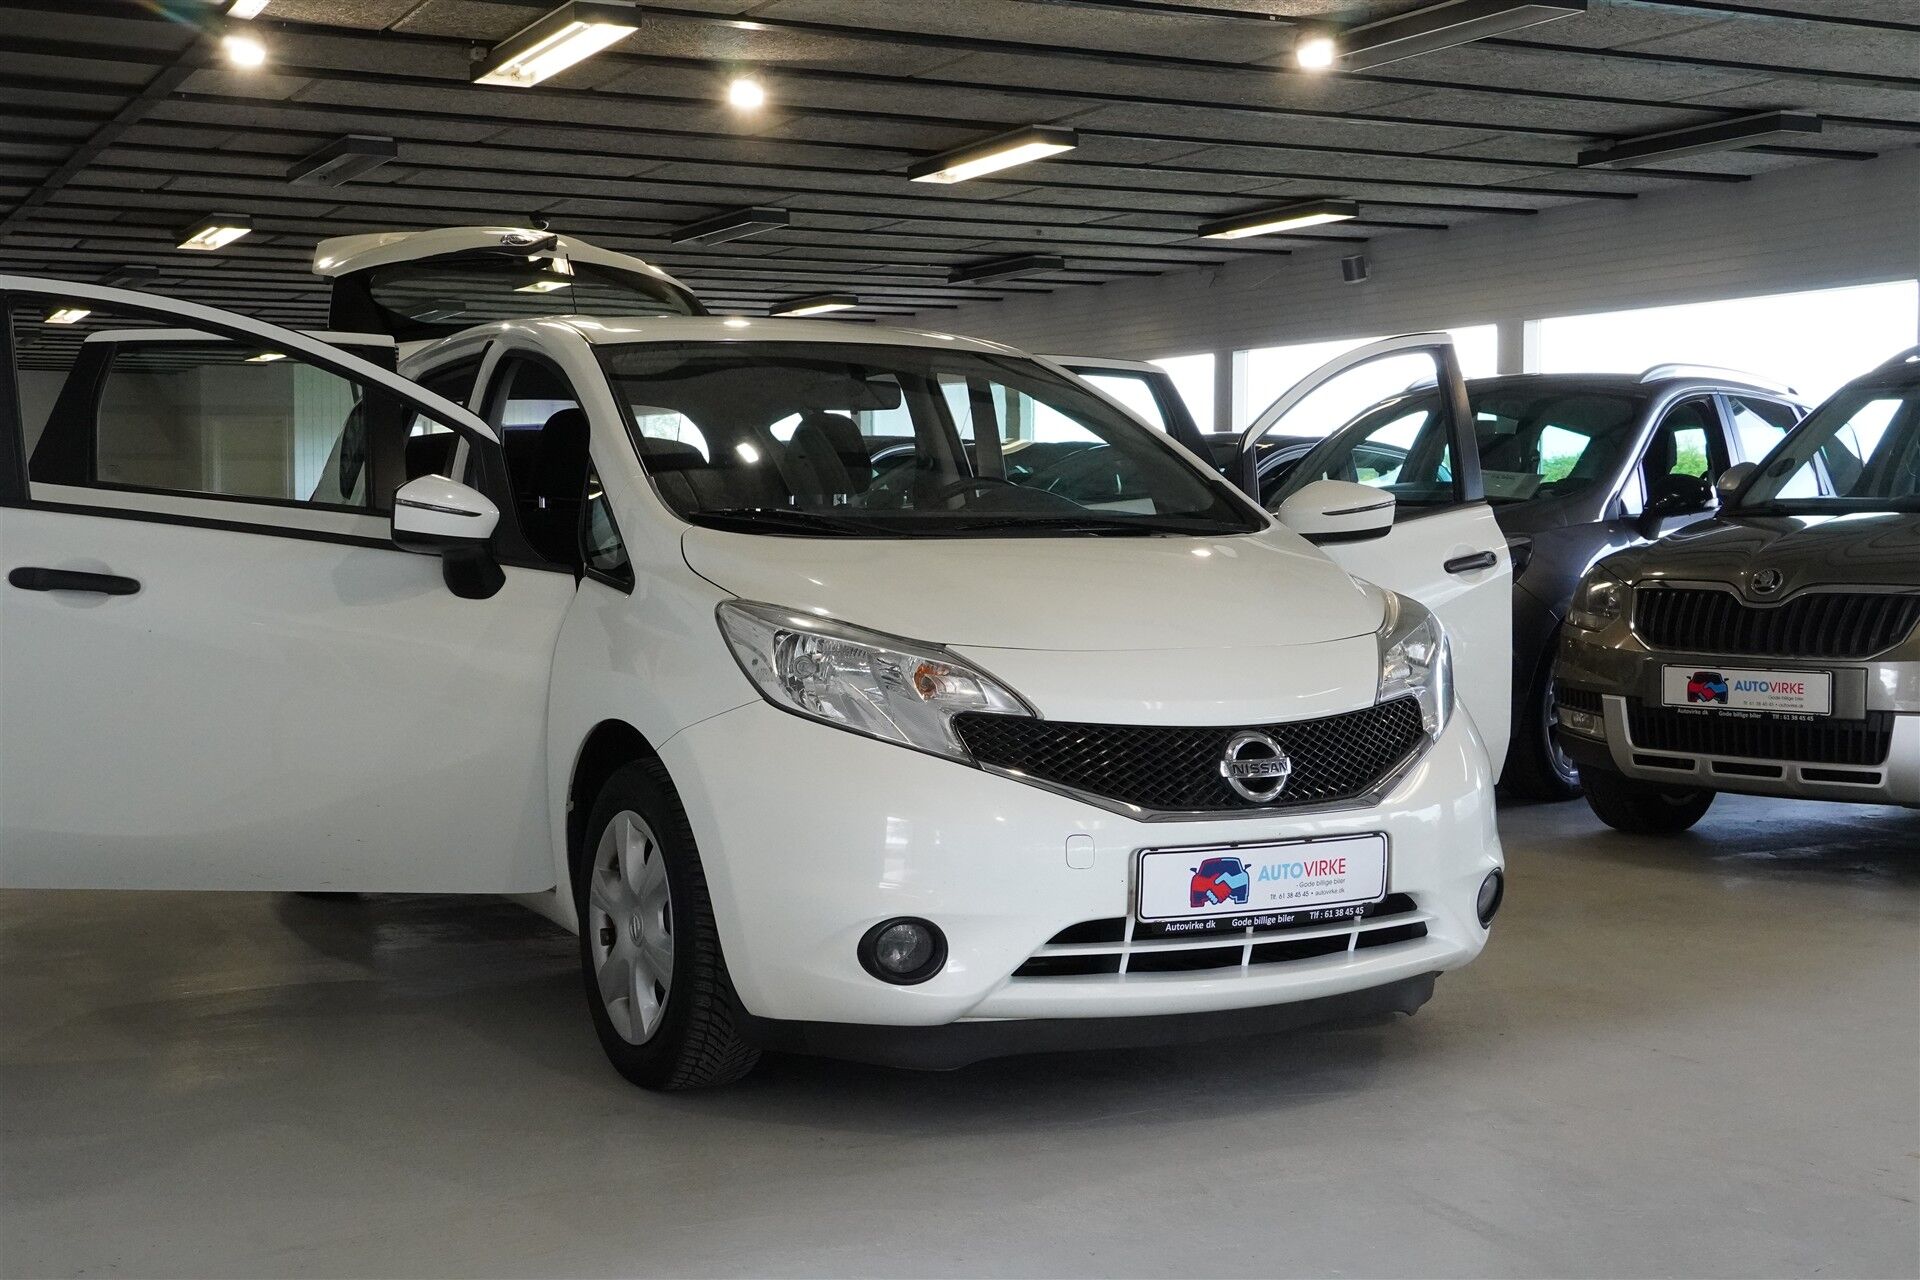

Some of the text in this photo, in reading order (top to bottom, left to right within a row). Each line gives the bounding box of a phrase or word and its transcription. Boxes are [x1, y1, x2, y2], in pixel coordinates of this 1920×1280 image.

[1734, 680, 1804, 694] AUTOVIRKE
[1232, 761, 1288, 775] NISSAN
[1258, 858, 1347, 881] AUTOVIRKE
[1165, 921, 1204, 932] Autovirke
[1206, 920, 1216, 929] dk
[1231, 917, 1252, 926] Gode
[1254, 916, 1276, 926] billige
[1278, 914, 1295, 923] biler
[1324, 910, 1333, 918] 61
[1334, 908, 1344, 917] 38
[1344, 908, 1354, 916] 45
[1354, 906, 1364, 915] 45
